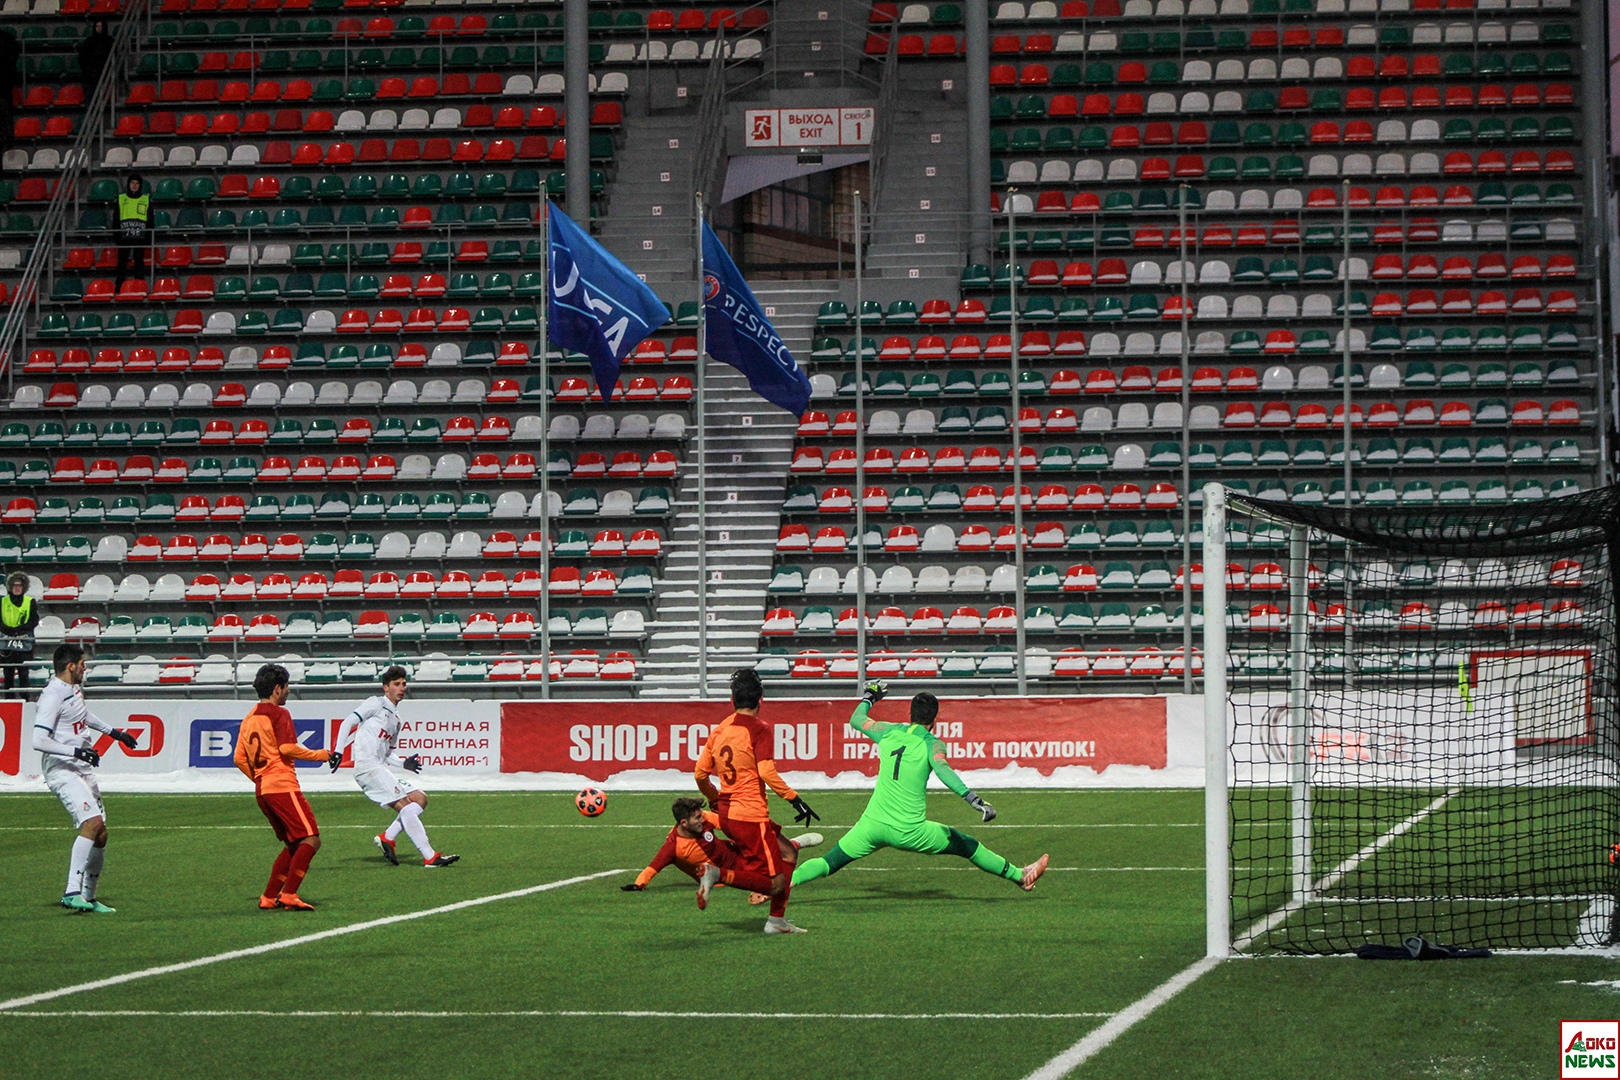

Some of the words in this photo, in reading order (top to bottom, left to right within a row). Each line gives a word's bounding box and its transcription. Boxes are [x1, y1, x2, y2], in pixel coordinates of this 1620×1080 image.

[788, 113, 834, 125] ВЫХОД
[799, 127, 823, 138] EXIT
[855, 122, 861, 140] 1
[398, 721, 490, 732] АГОННАЯ
[249, 731, 268, 769] 2
[398, 738, 490, 749] ЕМОНТНАЯ
[992, 740, 1096, 759] ПОКУПОК!
[719, 744, 737, 786] 3
[889, 745, 907, 781] 1
